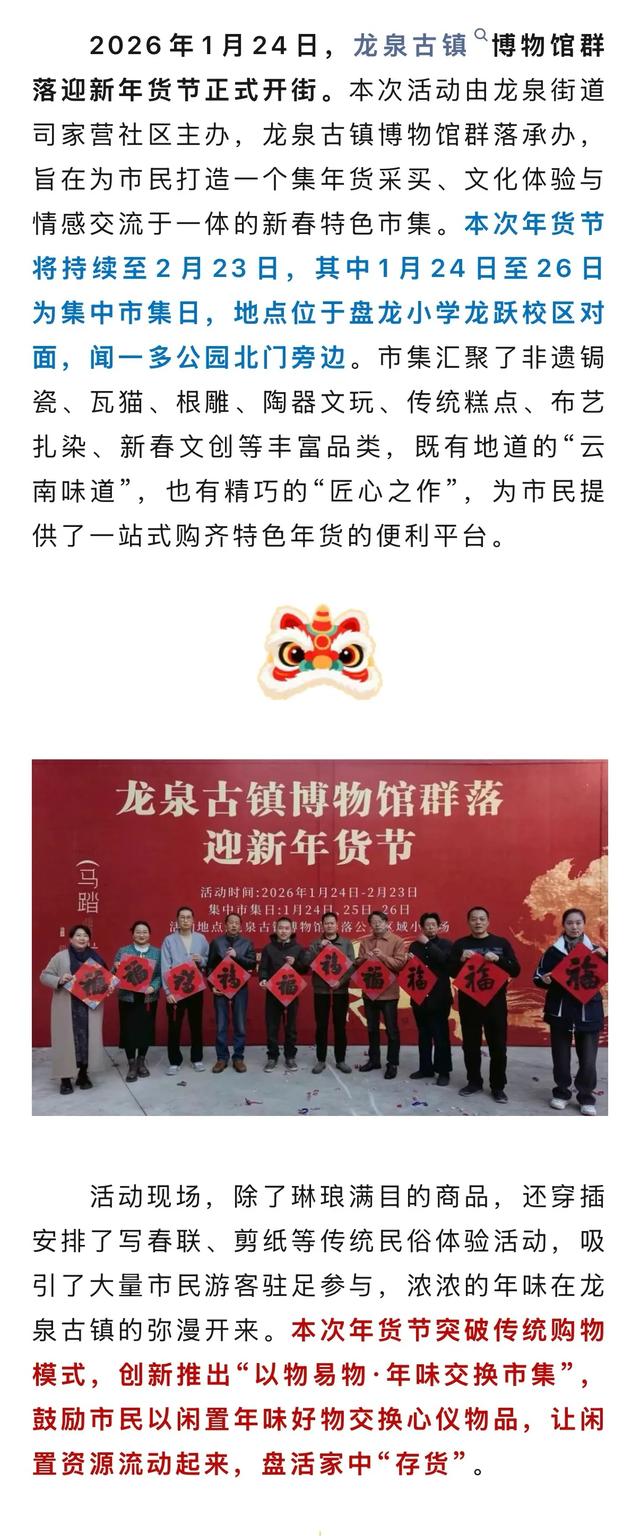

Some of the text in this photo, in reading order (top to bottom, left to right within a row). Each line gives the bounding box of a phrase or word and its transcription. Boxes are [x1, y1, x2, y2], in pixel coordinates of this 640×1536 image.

[116, 780, 503, 818] 龙泉古镇博物馆群落
[203, 828, 416, 865] 迎新年货节
[407, 965, 428, 991] 福
[465, 962, 495, 992] 福
[566, 955, 600, 990] 福
